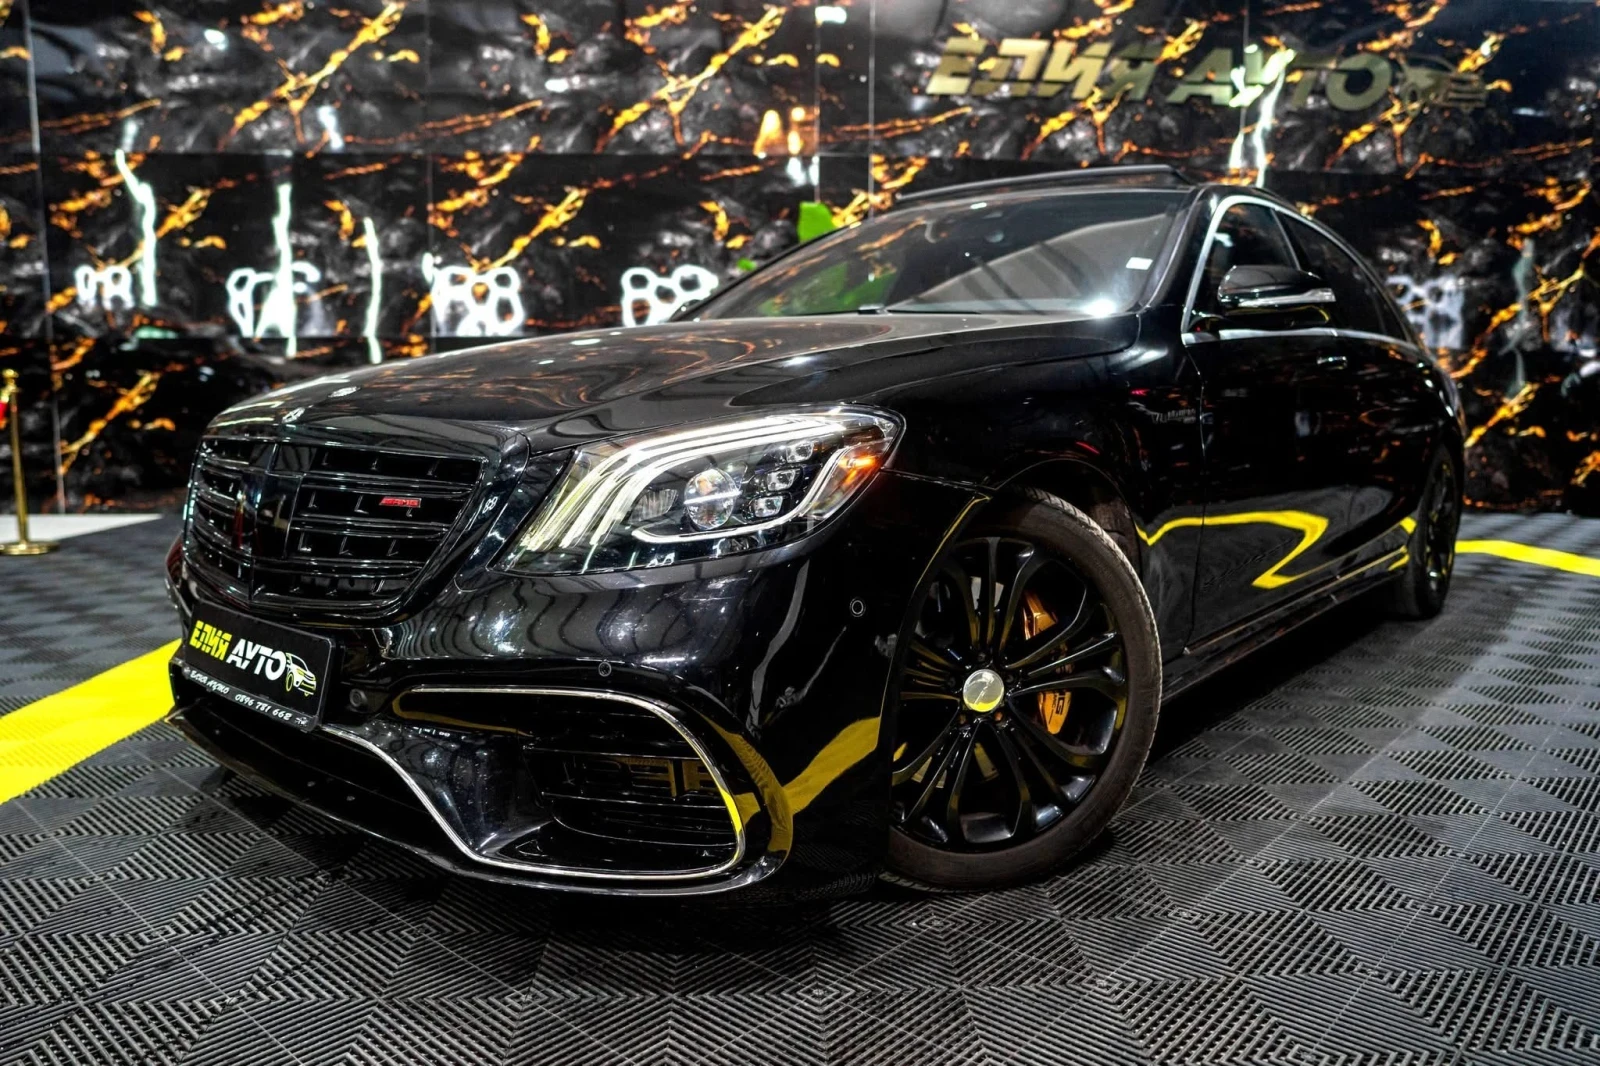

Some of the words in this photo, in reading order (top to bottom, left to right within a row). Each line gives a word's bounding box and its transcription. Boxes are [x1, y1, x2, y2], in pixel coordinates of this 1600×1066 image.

[925, 37, 1158, 99] ЕЛИЯ
[189, 620, 232, 660] ЕЛИЯ
[235, 694, 254, 707] 0896
[256, 701, 271, 713] 781
